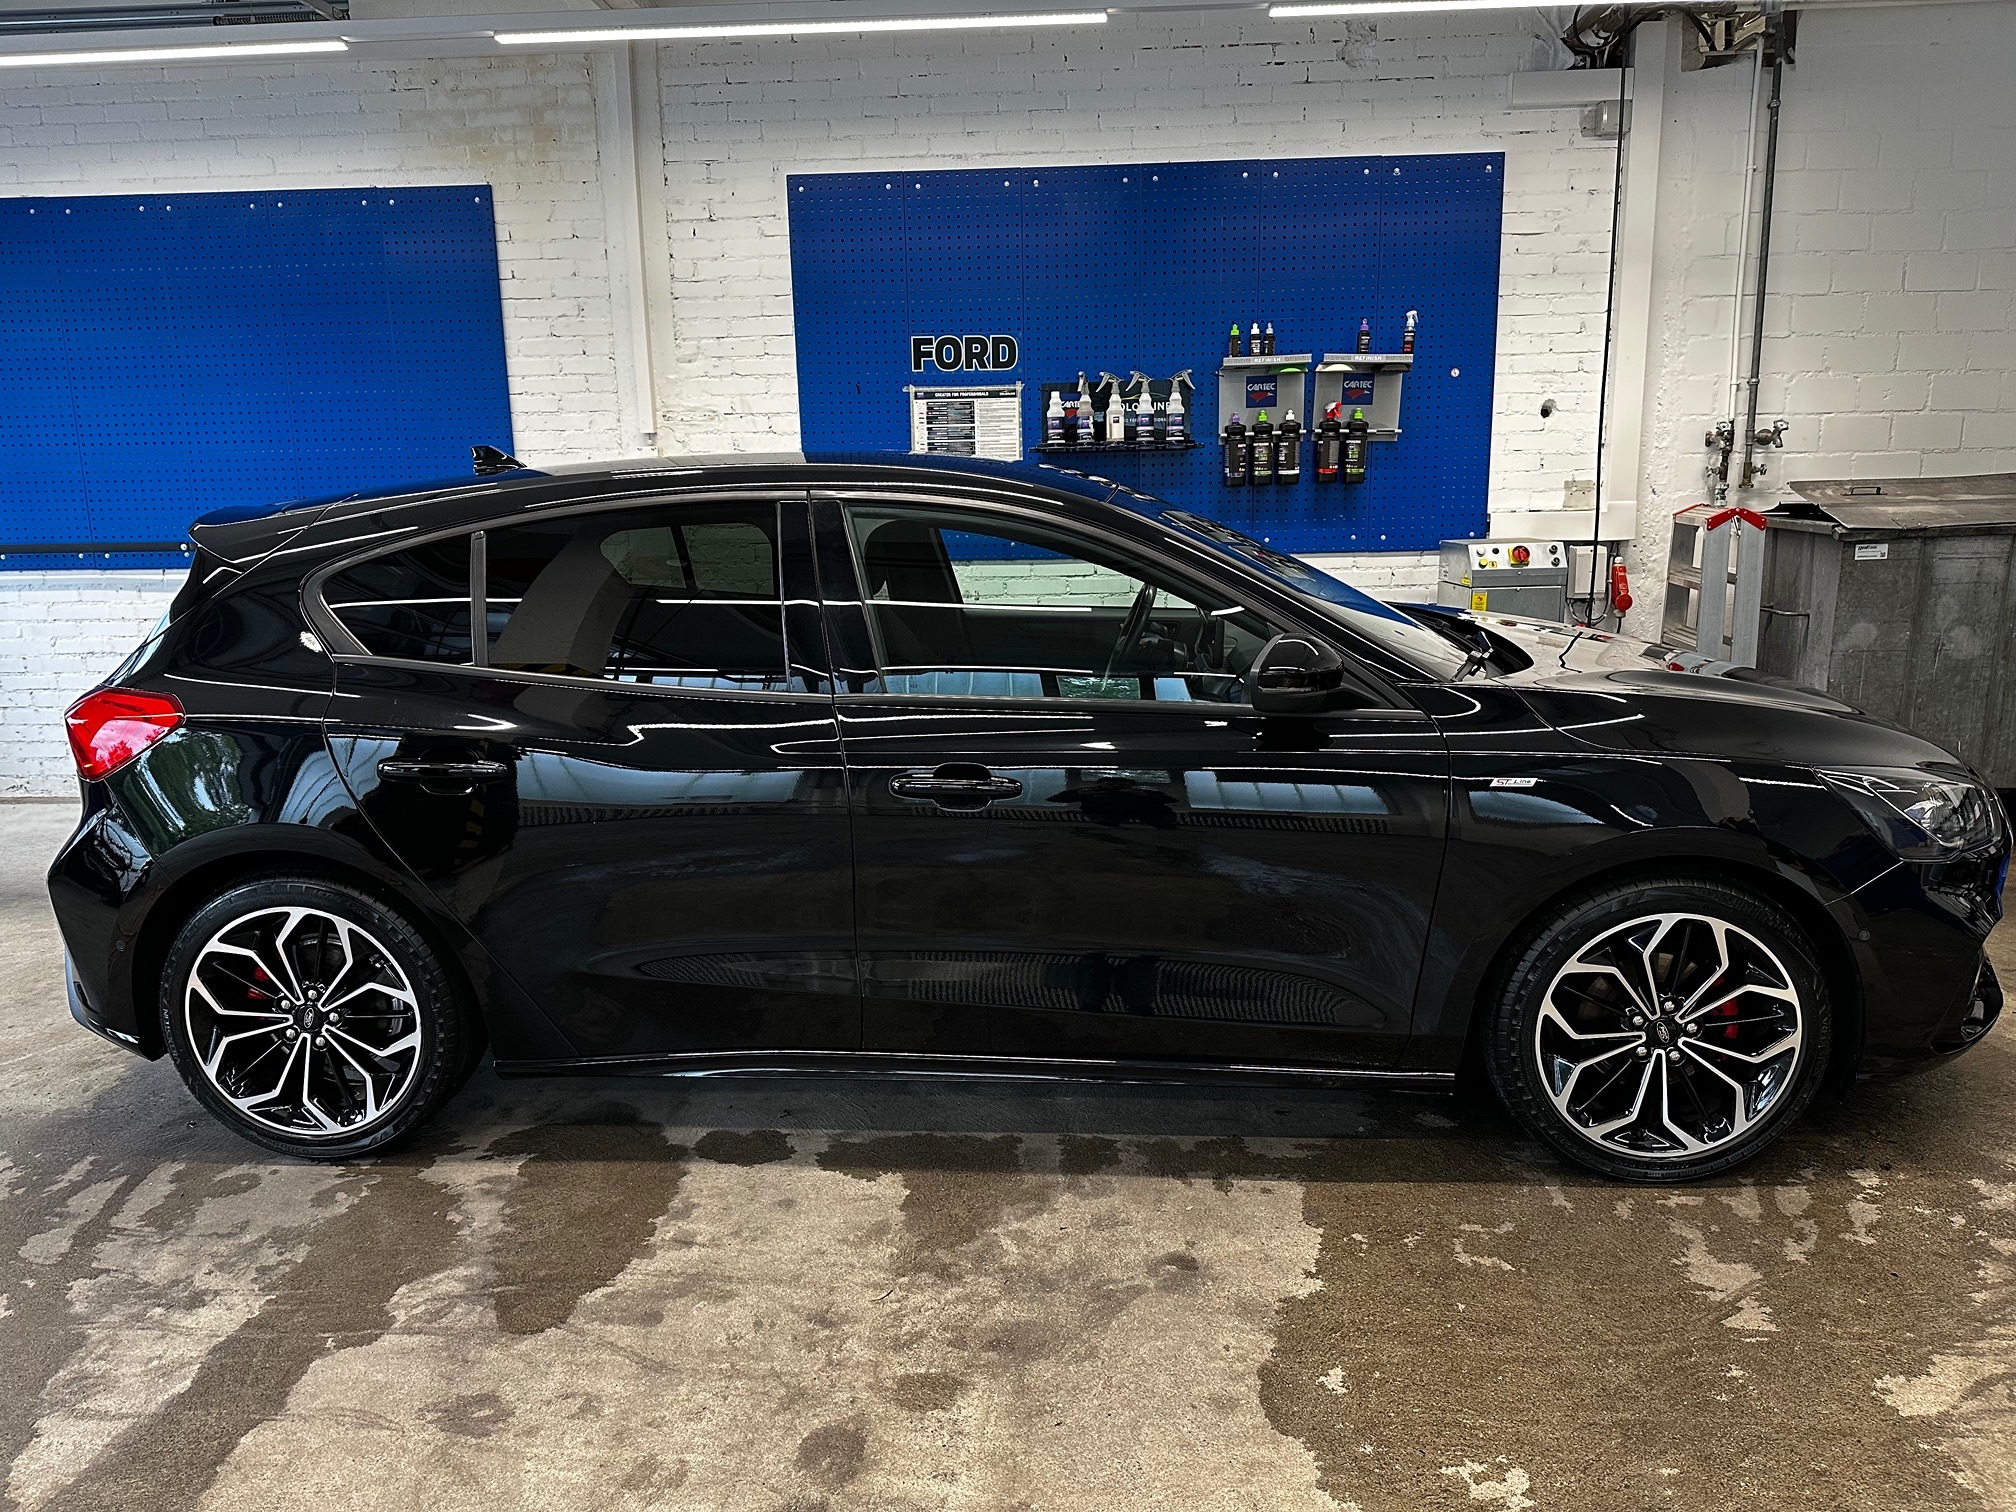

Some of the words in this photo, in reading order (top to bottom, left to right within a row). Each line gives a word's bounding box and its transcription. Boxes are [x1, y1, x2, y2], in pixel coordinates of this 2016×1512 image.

[911, 335, 1018, 371] FORD
[1247, 382, 1276, 391] CARTEC
[1344, 380, 1373, 389] CARTEC
